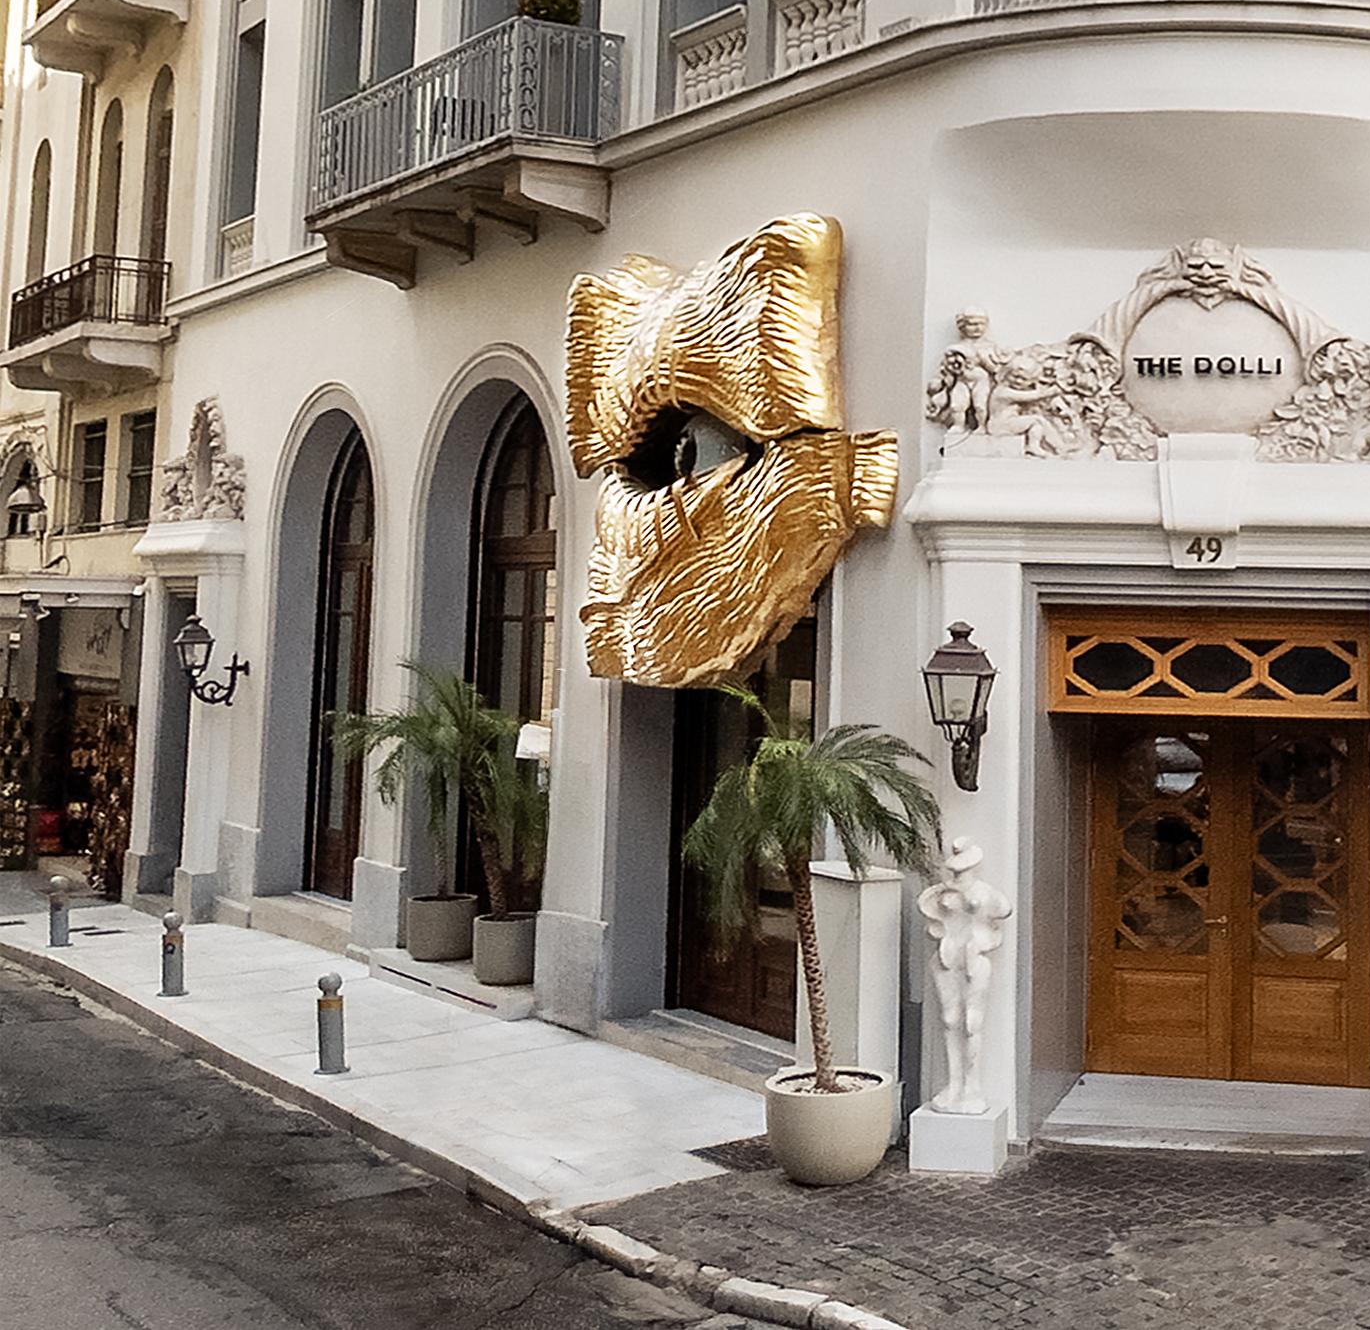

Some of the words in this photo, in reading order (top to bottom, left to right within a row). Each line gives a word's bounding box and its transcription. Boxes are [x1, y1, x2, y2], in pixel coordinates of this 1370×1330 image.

[1133, 357, 1182, 376] THE
[1195, 357, 1281, 375] DOLLI
[1186, 537, 1222, 562] 49
